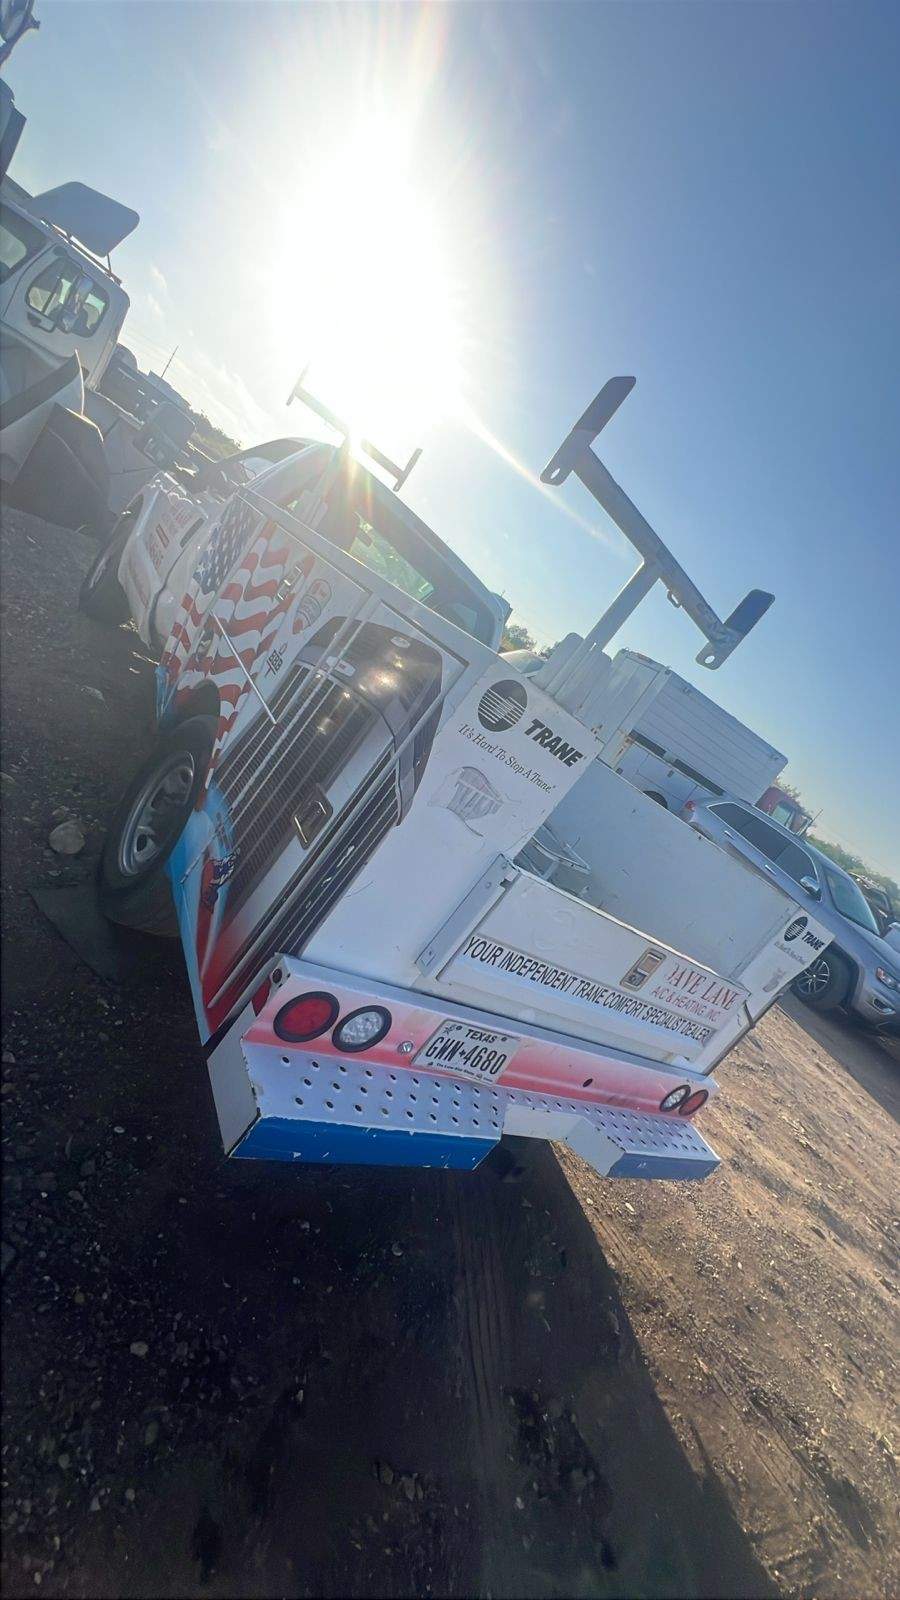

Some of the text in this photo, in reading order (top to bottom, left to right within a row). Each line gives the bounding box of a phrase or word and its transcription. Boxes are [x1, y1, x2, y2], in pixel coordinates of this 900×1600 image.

[472, 733, 498, 755] Hard
[495, 747, 507, 762] To
[504, 755, 524, 776] Stop
[522, 768, 532, 779] A
[524, 718, 584, 768] TRANE
[801, 930, 826, 951] TRANE
[463, 936, 711, 1043] YOUR INDEPENDENT TRANE COMFORT SPECIALIST DEALER
[701, 981, 739, 1011] LANE
[464, 1028, 498, 1044] TEXAS
